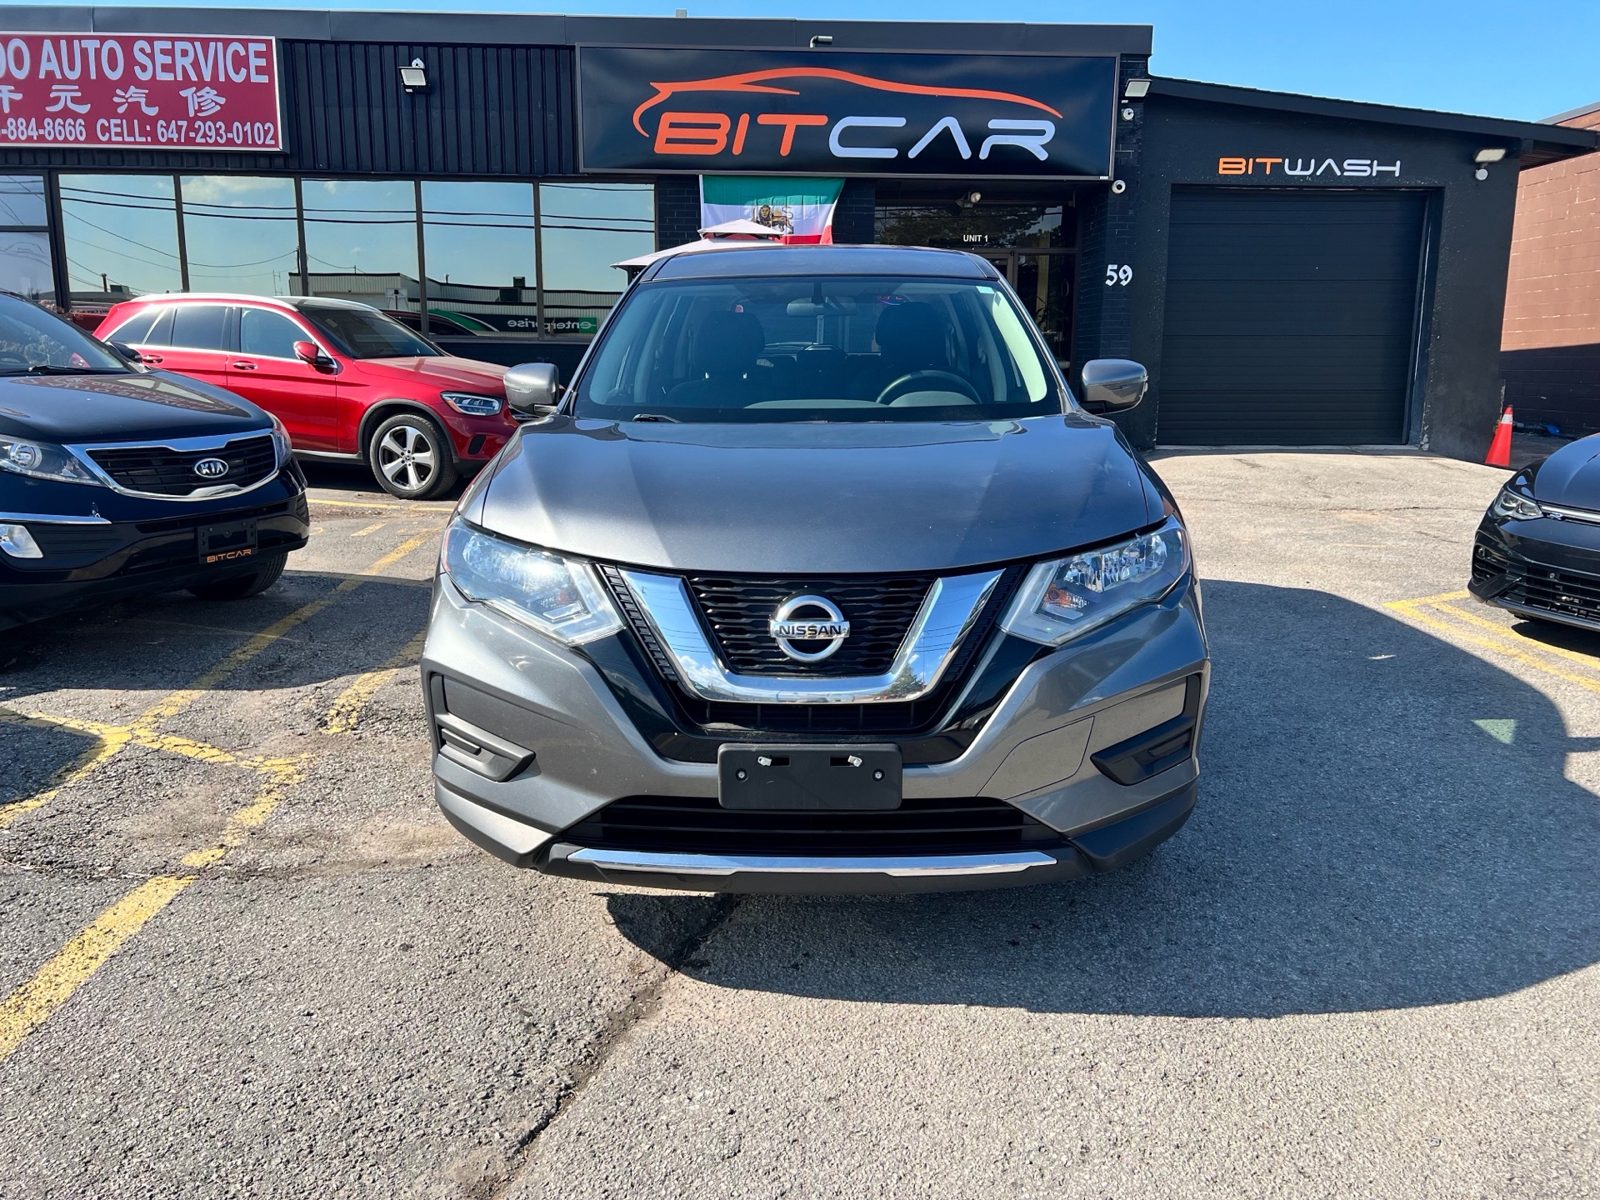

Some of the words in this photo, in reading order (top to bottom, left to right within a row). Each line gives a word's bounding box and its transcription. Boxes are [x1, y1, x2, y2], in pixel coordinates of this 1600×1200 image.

[0, 38, 30, 80] O
[39, 39, 124, 80] AUTO
[133, 40, 269, 83] SERVICE
[96, 118, 151, 142] CELL:
[157, 119, 276, 144] 647-293-0102
[654, 111, 1056, 161] BITCAR
[1218, 157, 1401, 177] BITWASH
[963, 234, 982, 242] UNIT
[1104, 264, 1133, 287] 59
[200, 462, 224, 475] KIA
[206, 549, 252, 563] BITCAR
[780, 625, 842, 635] NISSAN
